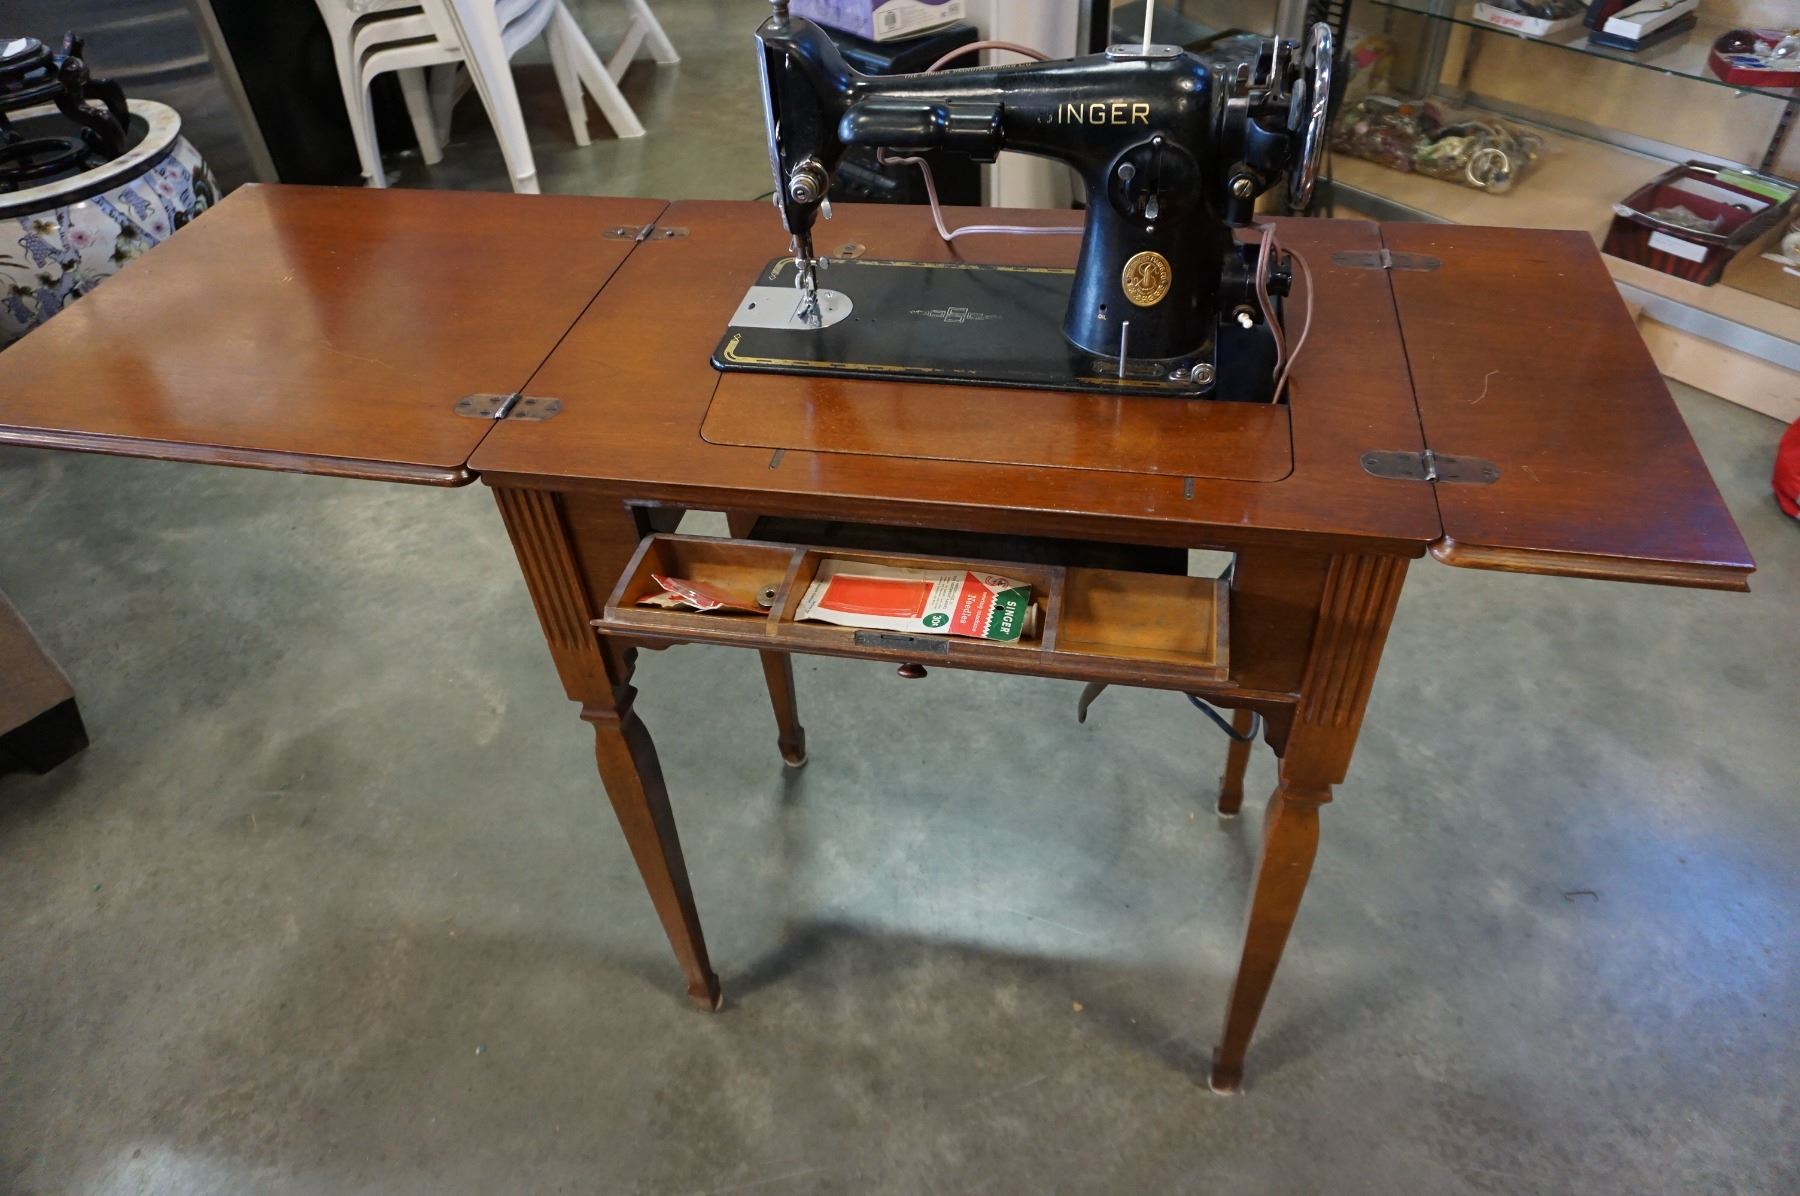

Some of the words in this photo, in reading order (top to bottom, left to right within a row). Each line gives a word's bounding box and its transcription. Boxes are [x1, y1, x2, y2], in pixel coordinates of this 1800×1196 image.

[1037, 103, 1150, 124] INGER
[960, 594, 977, 624] Needles
[1000, 601, 1017, 633] SINGER
